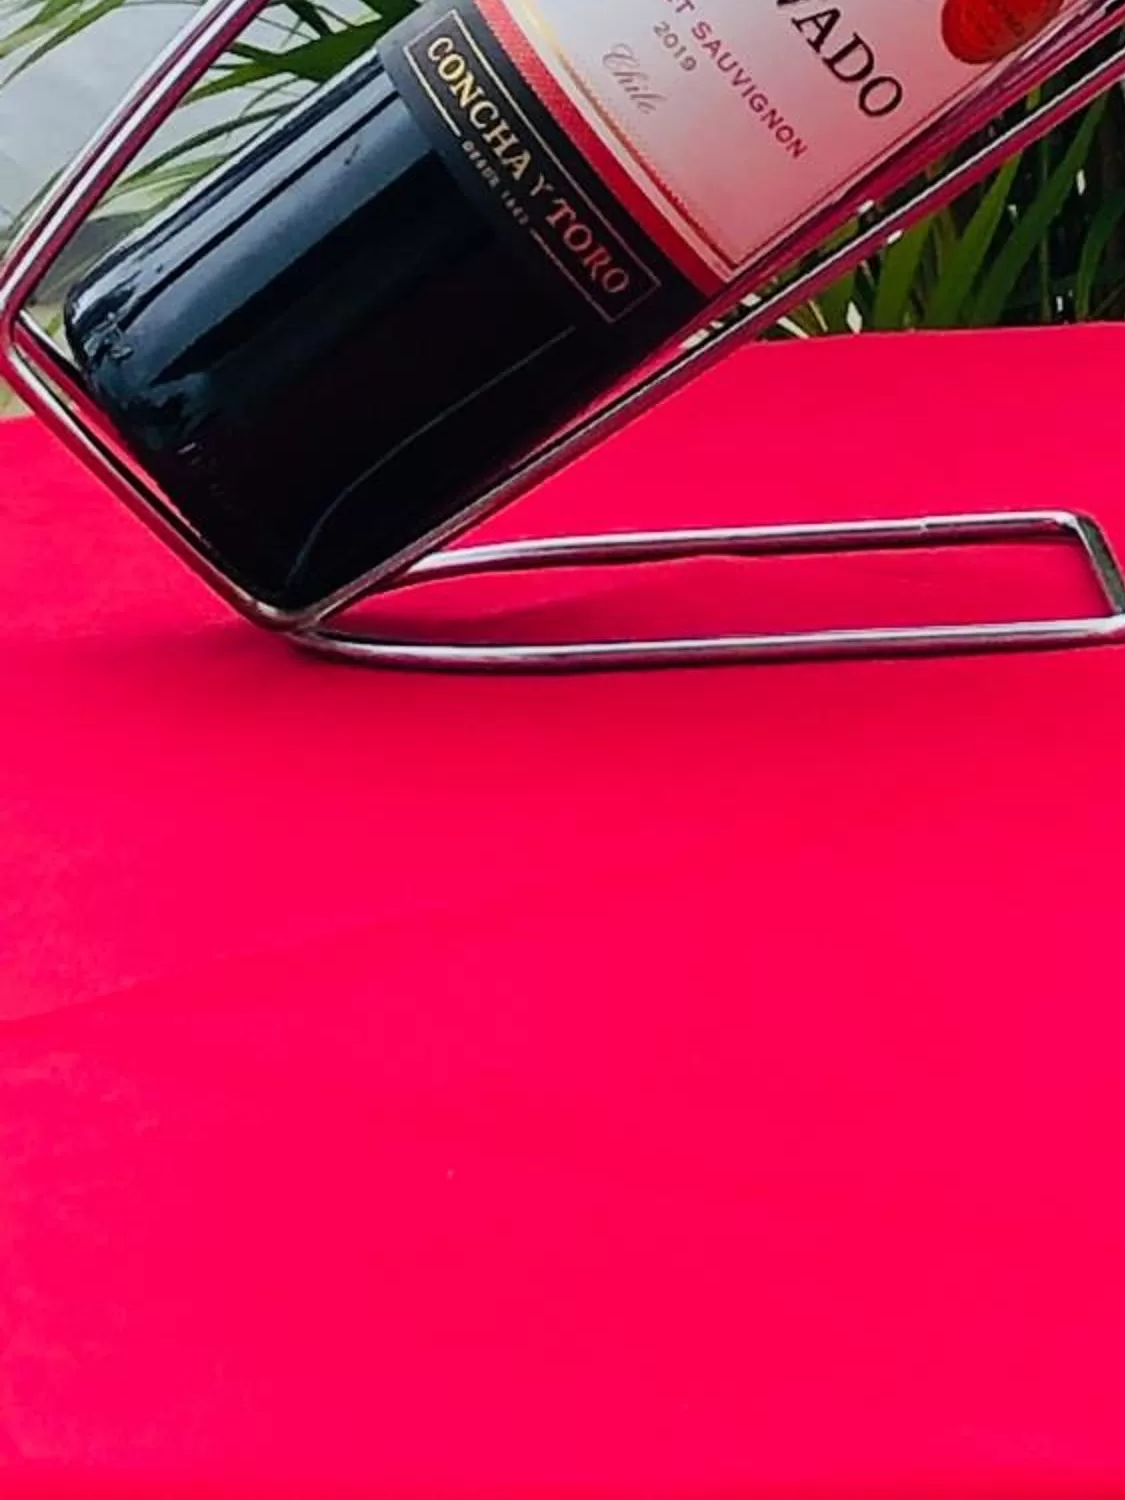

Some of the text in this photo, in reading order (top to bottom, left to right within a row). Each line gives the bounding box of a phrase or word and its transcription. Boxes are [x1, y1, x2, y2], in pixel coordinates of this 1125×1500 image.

[602, 42, 668, 115] Chile
[652, 20, 698, 73] 2019
[690, 19, 808, 160] SAUVIGNON
[427, 36, 630, 294] CONCHA Y TORO
